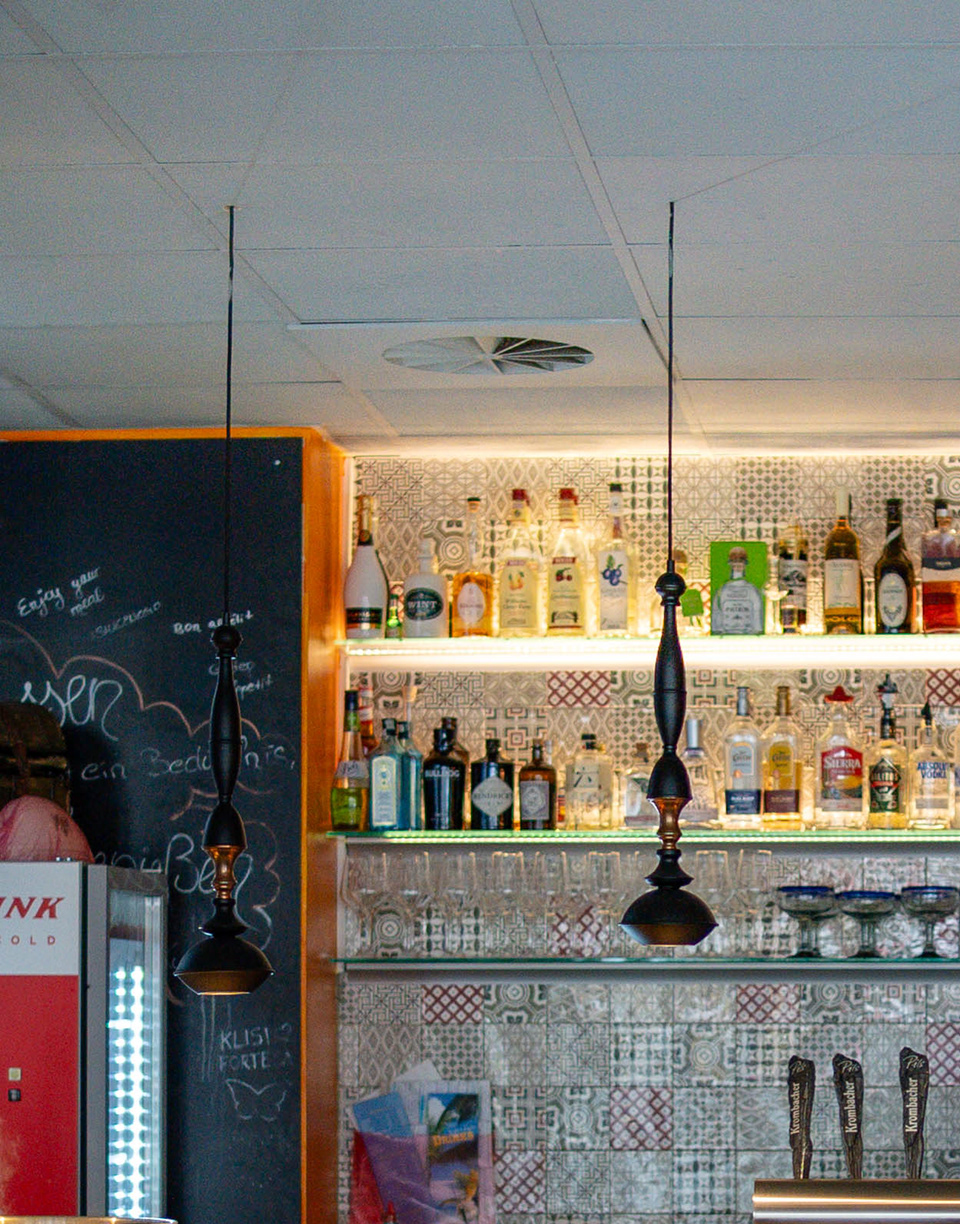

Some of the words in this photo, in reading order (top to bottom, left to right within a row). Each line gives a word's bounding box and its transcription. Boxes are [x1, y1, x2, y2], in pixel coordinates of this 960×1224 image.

[17, 587, 65, 617] Enjoy
[172, 622, 203, 636] Bon
[80, 763, 127, 781] ein
[424, 769, 460, 778] BULLDOG
[823, 757, 861, 770] SIERRA
[790, 1082, 801, 1135] Krombacher
[843, 1080, 859, 1133] Krombacher
[904, 1077, 919, 1133] Krombacher
